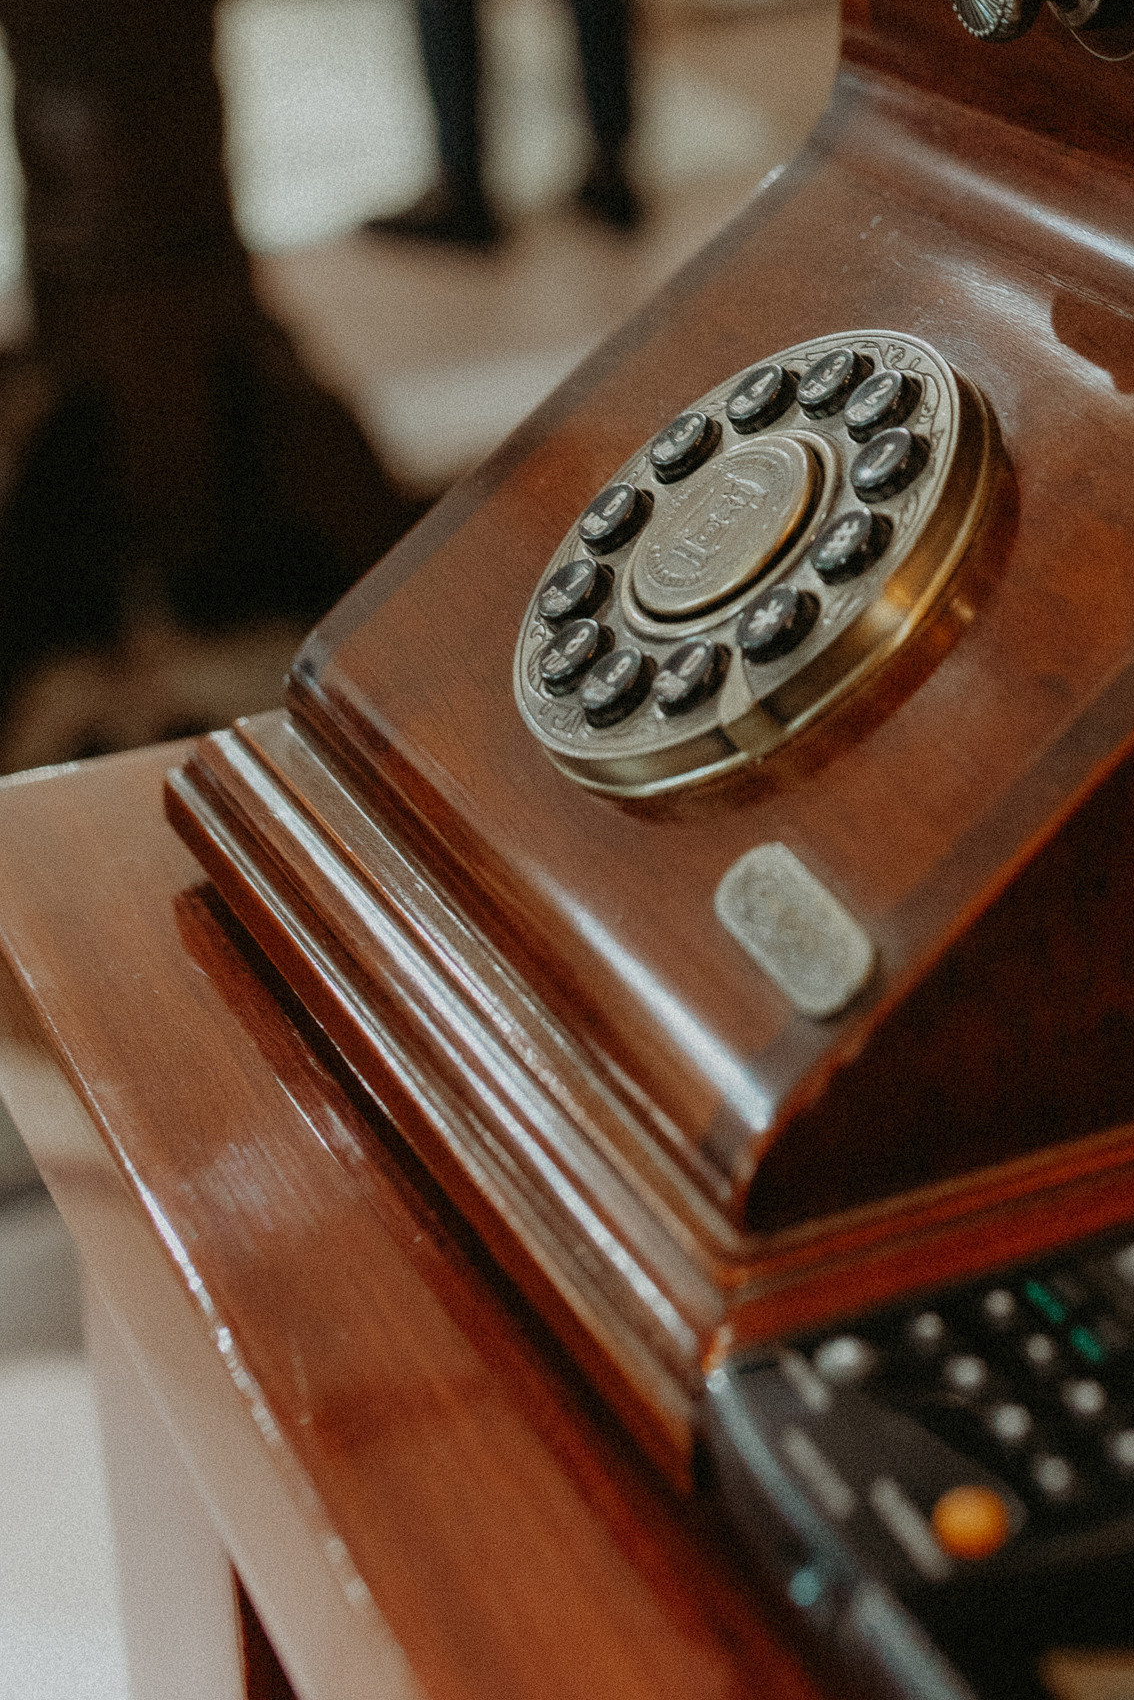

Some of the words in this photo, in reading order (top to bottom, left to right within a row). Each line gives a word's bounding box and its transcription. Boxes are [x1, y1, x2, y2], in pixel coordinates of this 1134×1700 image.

[821, 355, 846, 381] 3
[751, 372, 774, 398] 4
[865, 379, 893, 405] 2
[674, 417, 700, 442] 5
[602, 490, 628, 517] 6
[565, 565, 590, 591] 7
[564, 628, 590, 654] 8
[606, 656, 631, 683] 9
